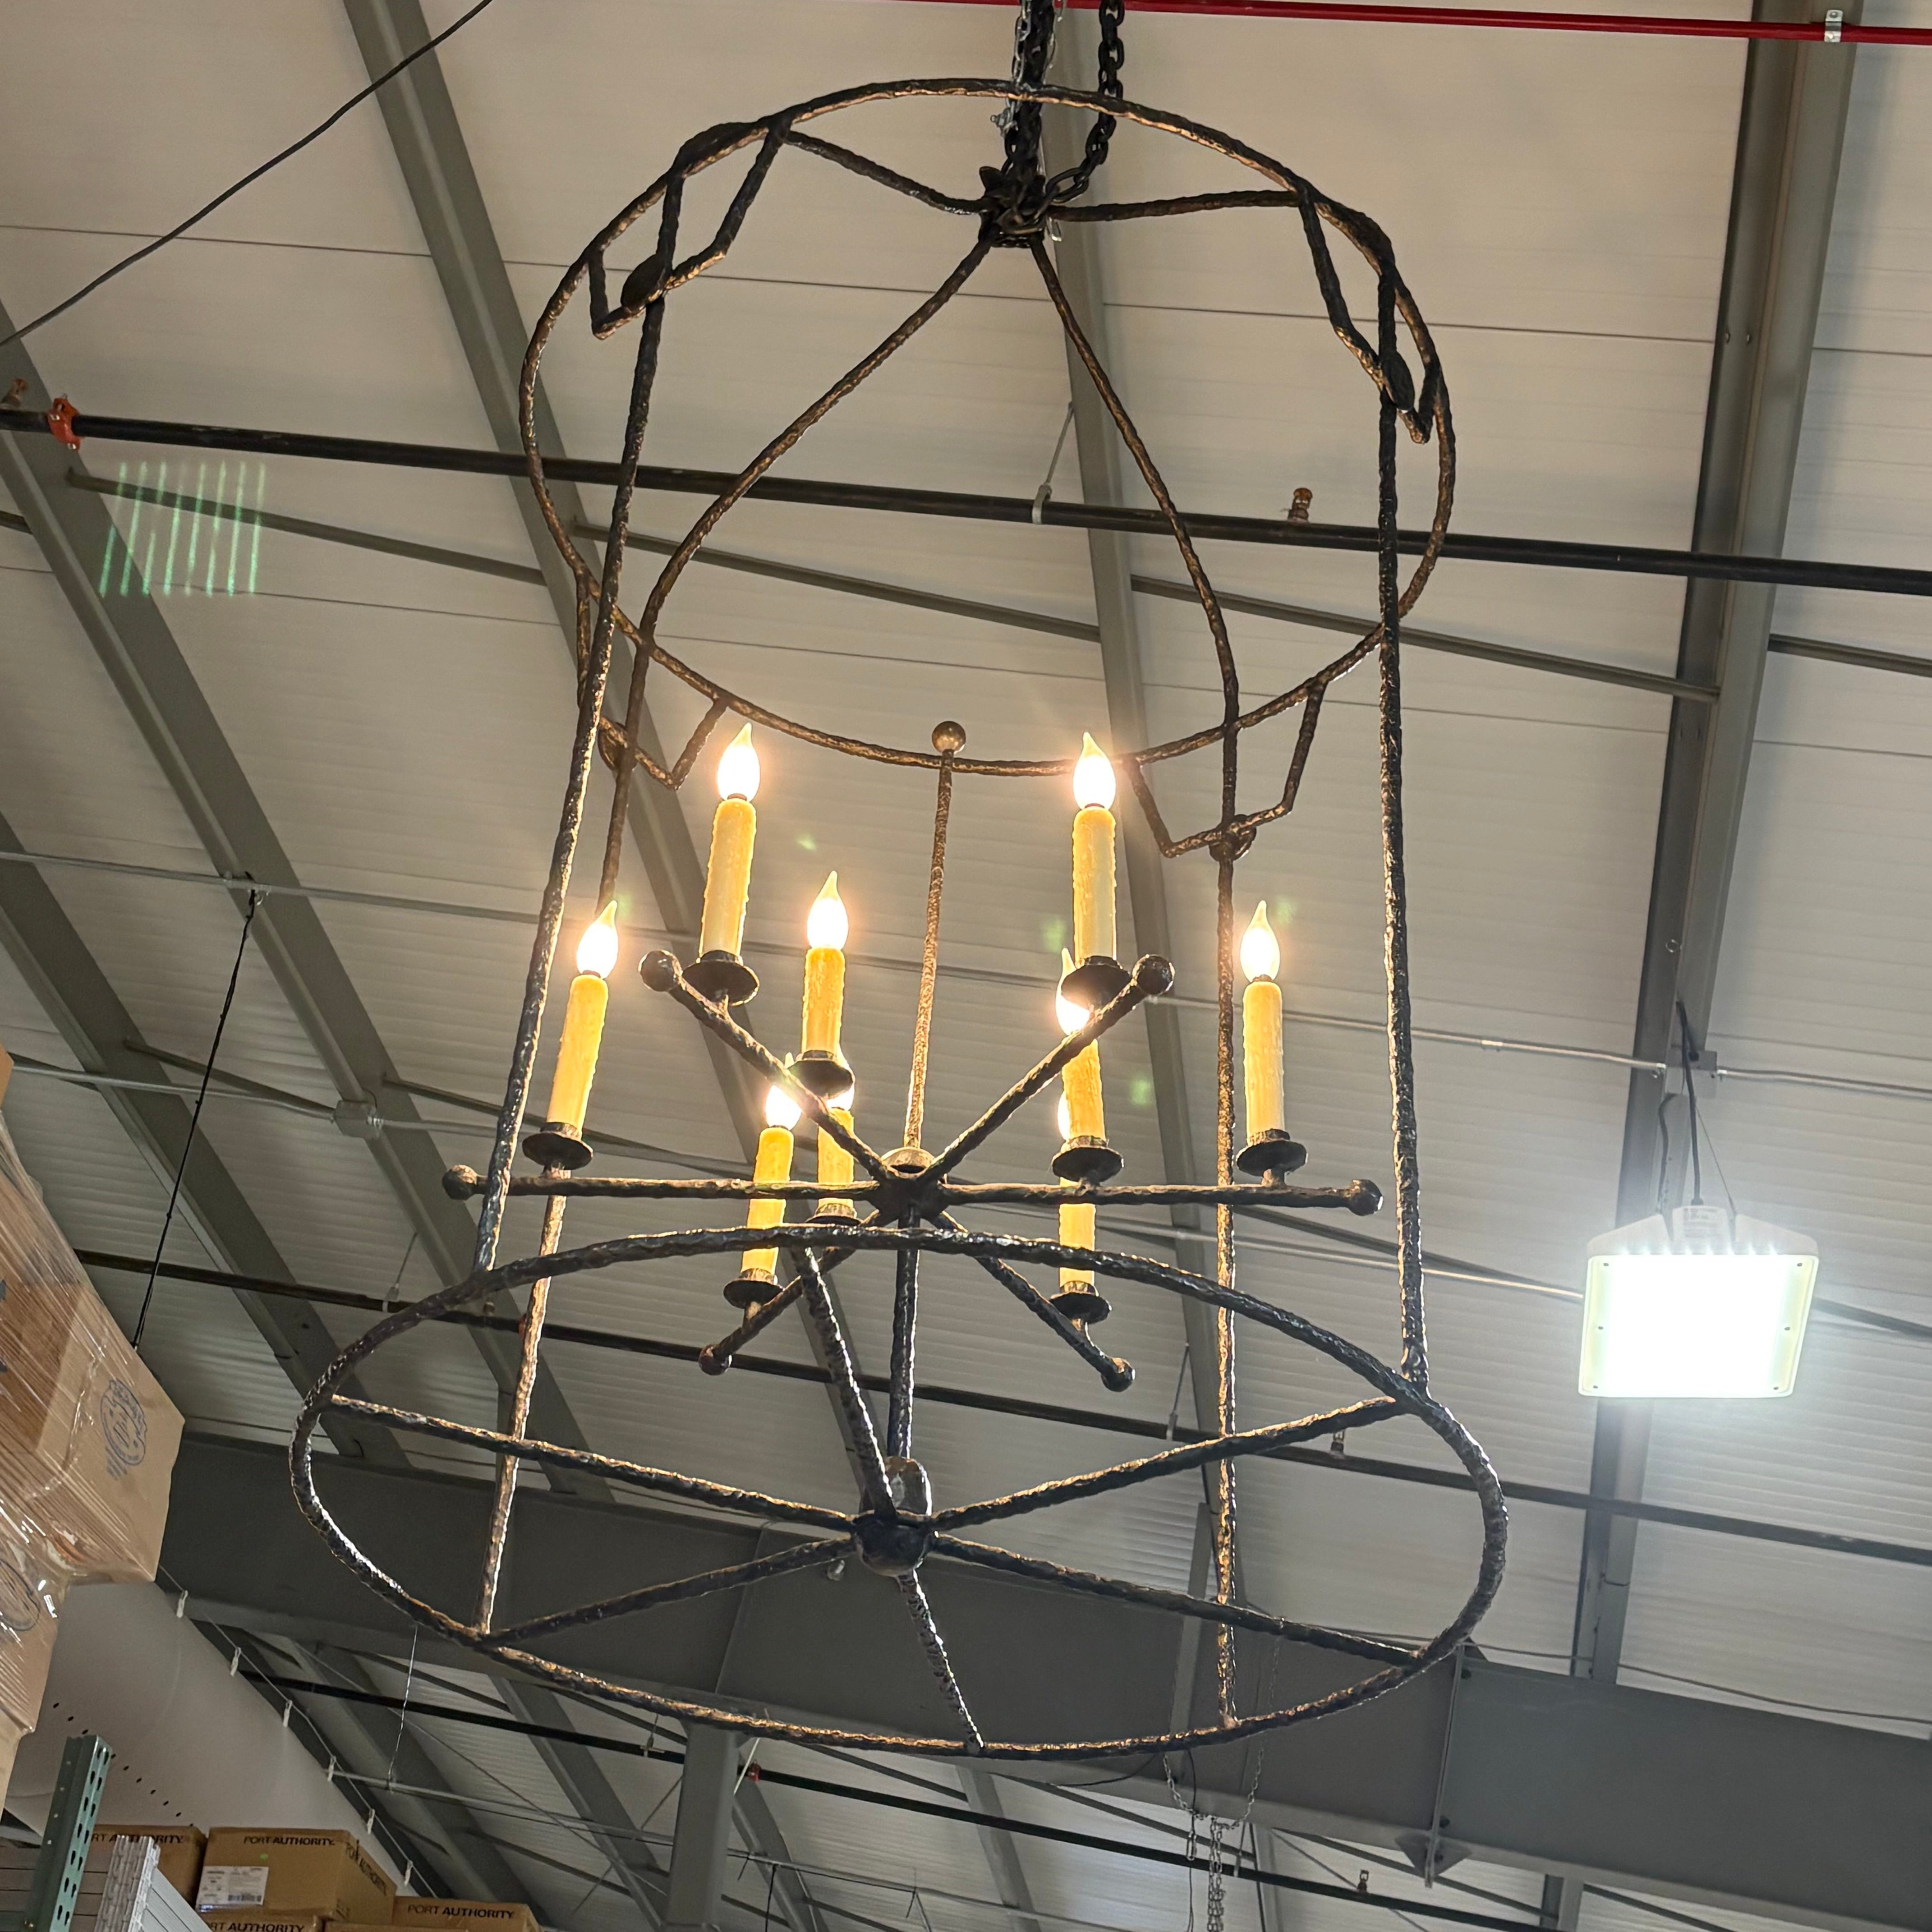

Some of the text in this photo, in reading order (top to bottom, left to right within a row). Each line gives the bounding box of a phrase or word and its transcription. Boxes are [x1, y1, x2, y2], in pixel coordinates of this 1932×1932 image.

[91, 1834, 107, 1842] RT
[408, 1904, 514, 1919] PORT AUTHORITY
[228, 1923, 304, 1932] AUTHORITY
